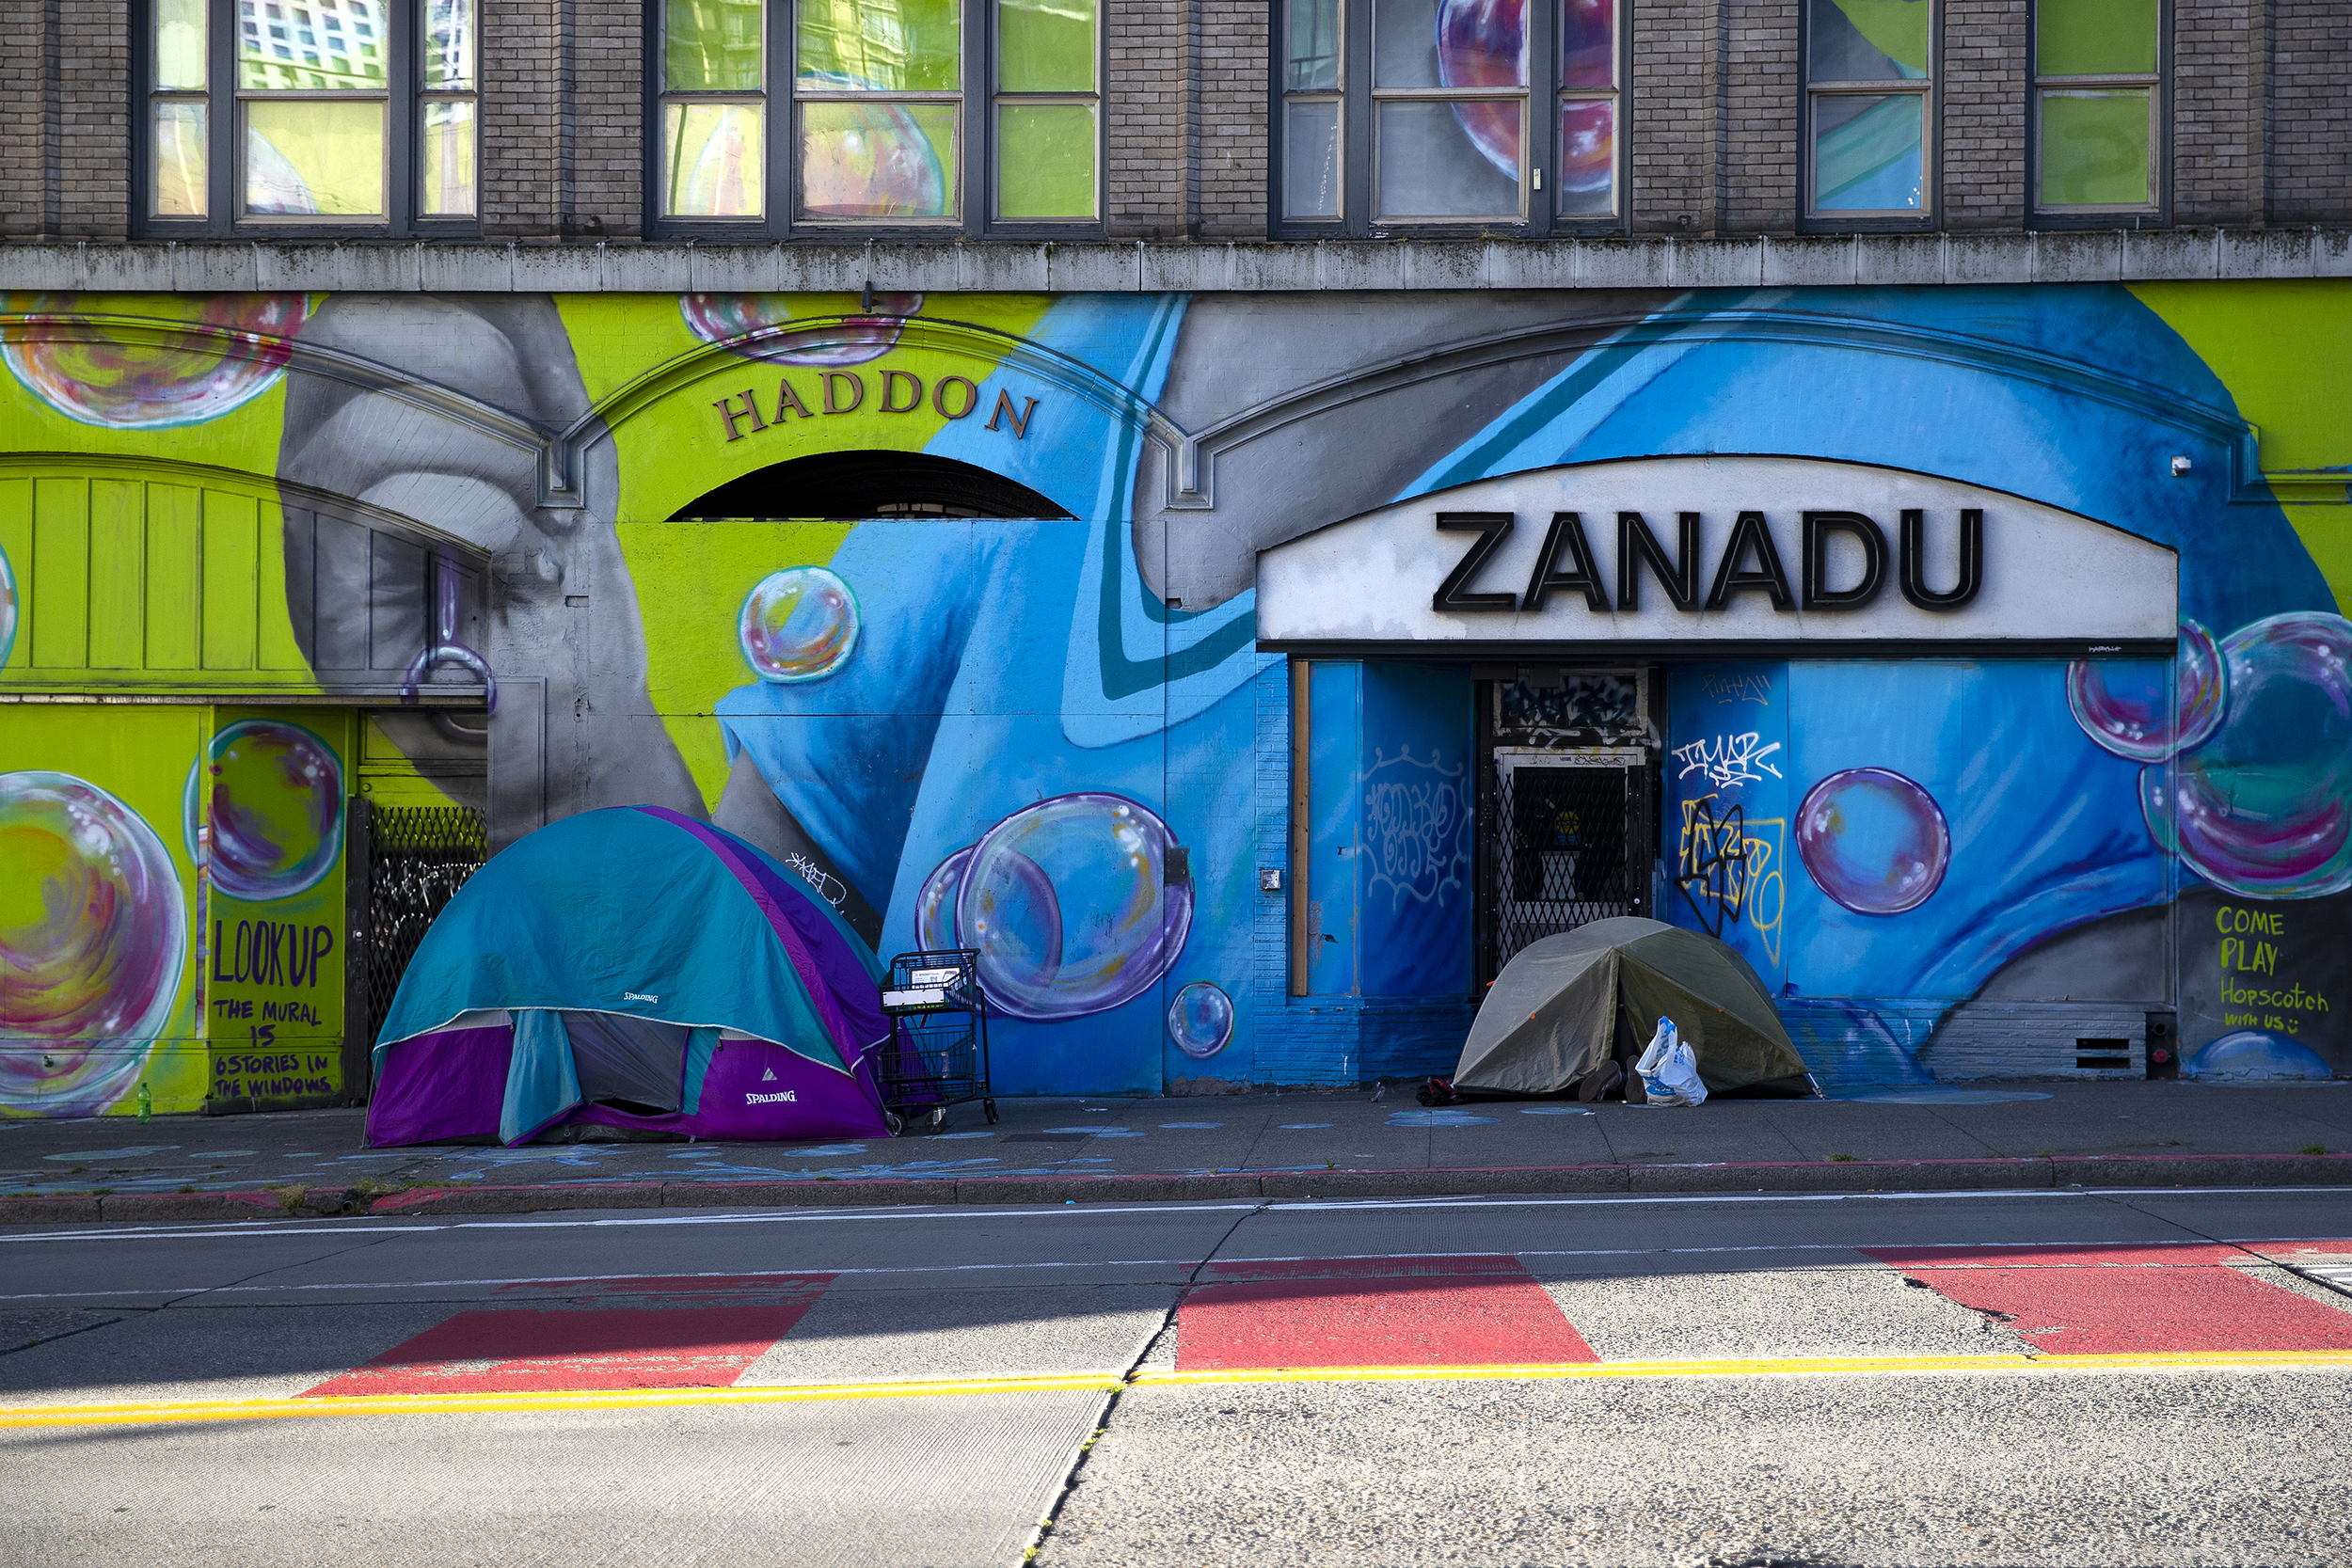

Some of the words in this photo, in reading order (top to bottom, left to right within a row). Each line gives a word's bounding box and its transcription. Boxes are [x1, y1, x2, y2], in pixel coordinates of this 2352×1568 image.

[712, 370, 1040, 442] HADDON
[1432, 508, 1984, 612] ZANADU
[2216, 906, 2285, 935] COME
[2220, 937, 2279, 976] PLAY
[623, 991, 659, 1004] SPALDING
[213, 998, 254, 1020] THE
[262, 1000, 322, 1027] MURAL
[2224, 1012, 2258, 1027] WITH
[2264, 1014, 2284, 1031] US
[308, 1054, 328, 1074] IN
[215, 1078, 242, 1098] THE
[247, 1076, 332, 1098] WINDOWS
[746, 1090, 797, 1105] SPALDING
